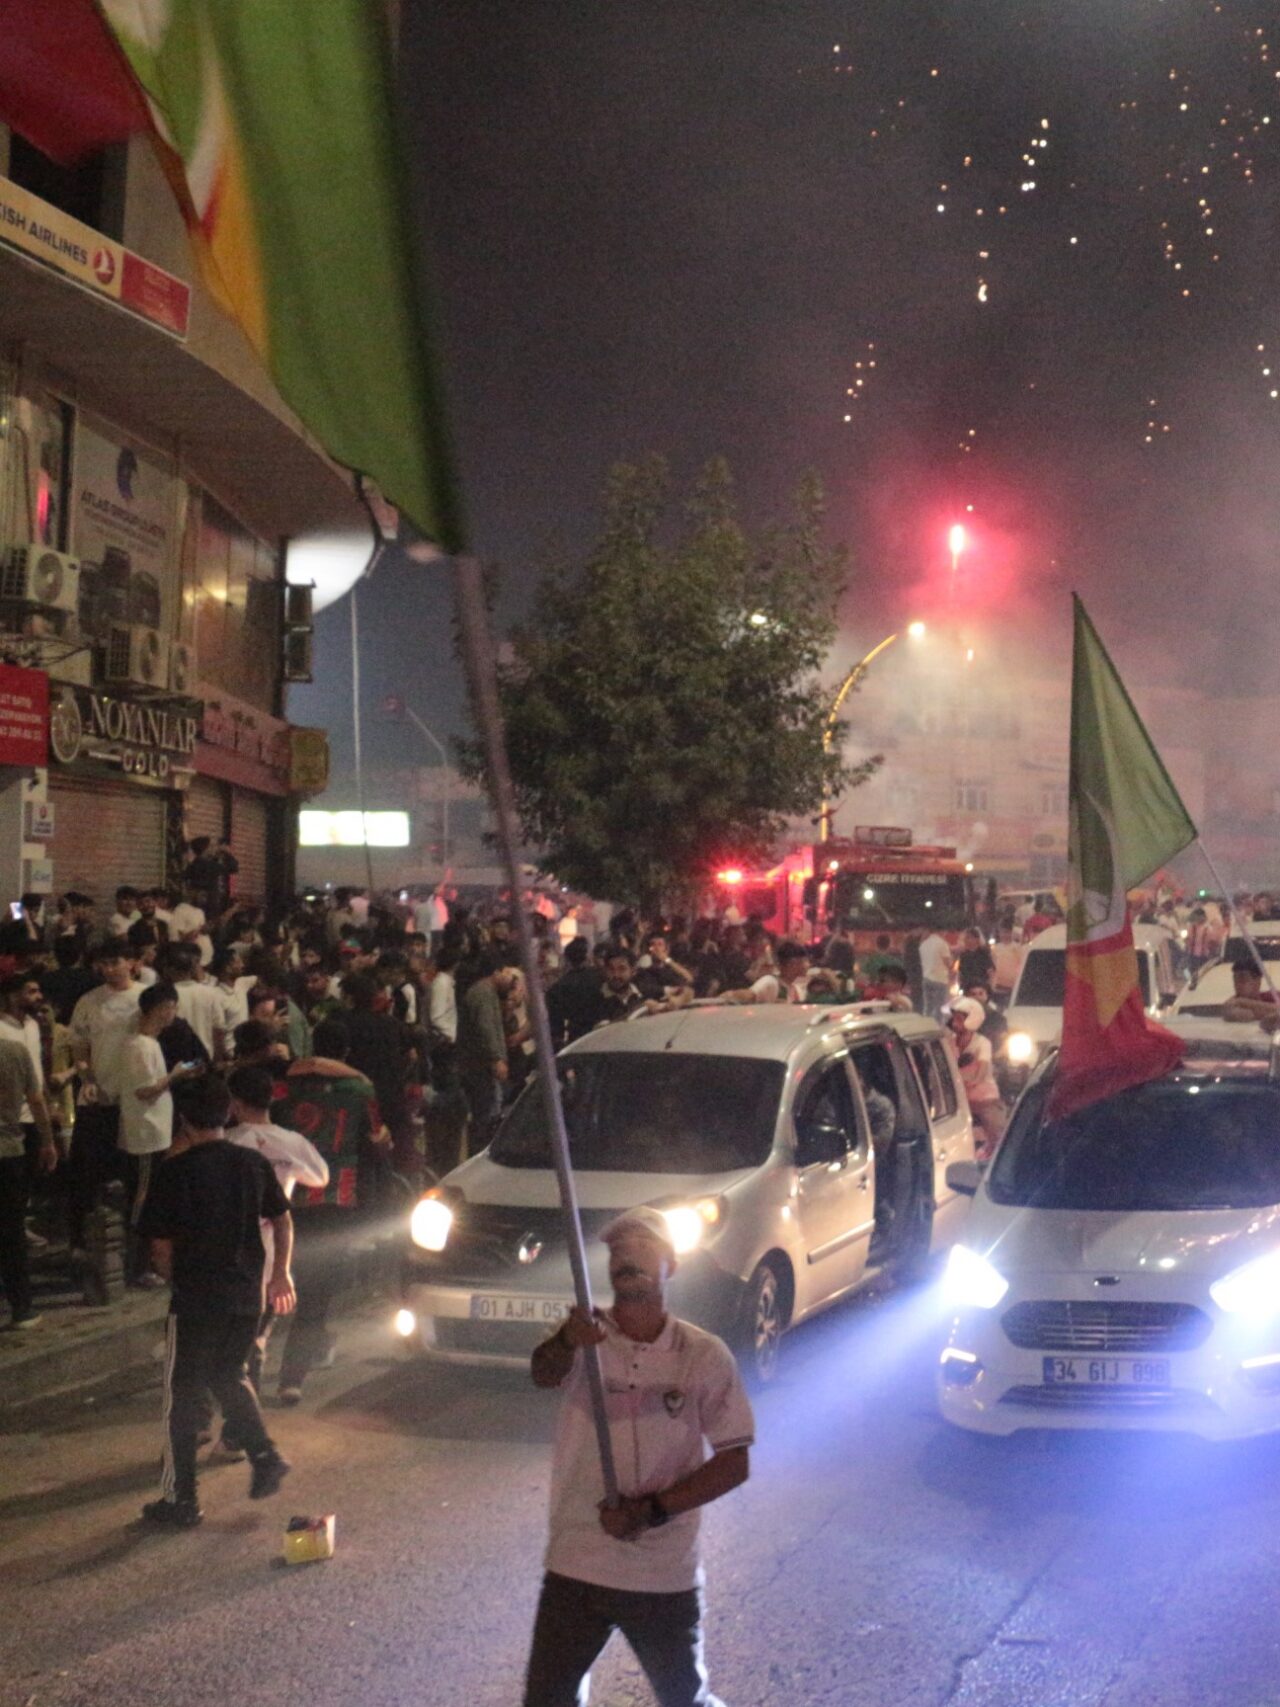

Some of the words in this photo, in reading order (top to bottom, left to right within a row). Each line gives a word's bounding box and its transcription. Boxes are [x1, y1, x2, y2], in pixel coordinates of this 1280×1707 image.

[0, 203, 26, 231] ISH
[28, 221, 88, 265] AIRLINES
[86, 693, 197, 753] NOYANLAR
[123, 748, 169, 777] GOLD
[480, 1300, 497, 1317] 01
[505, 1301, 535, 1318] AJH
[543, 1302, 570, 1320] 05
[1054, 1360, 1076, 1380] 34
